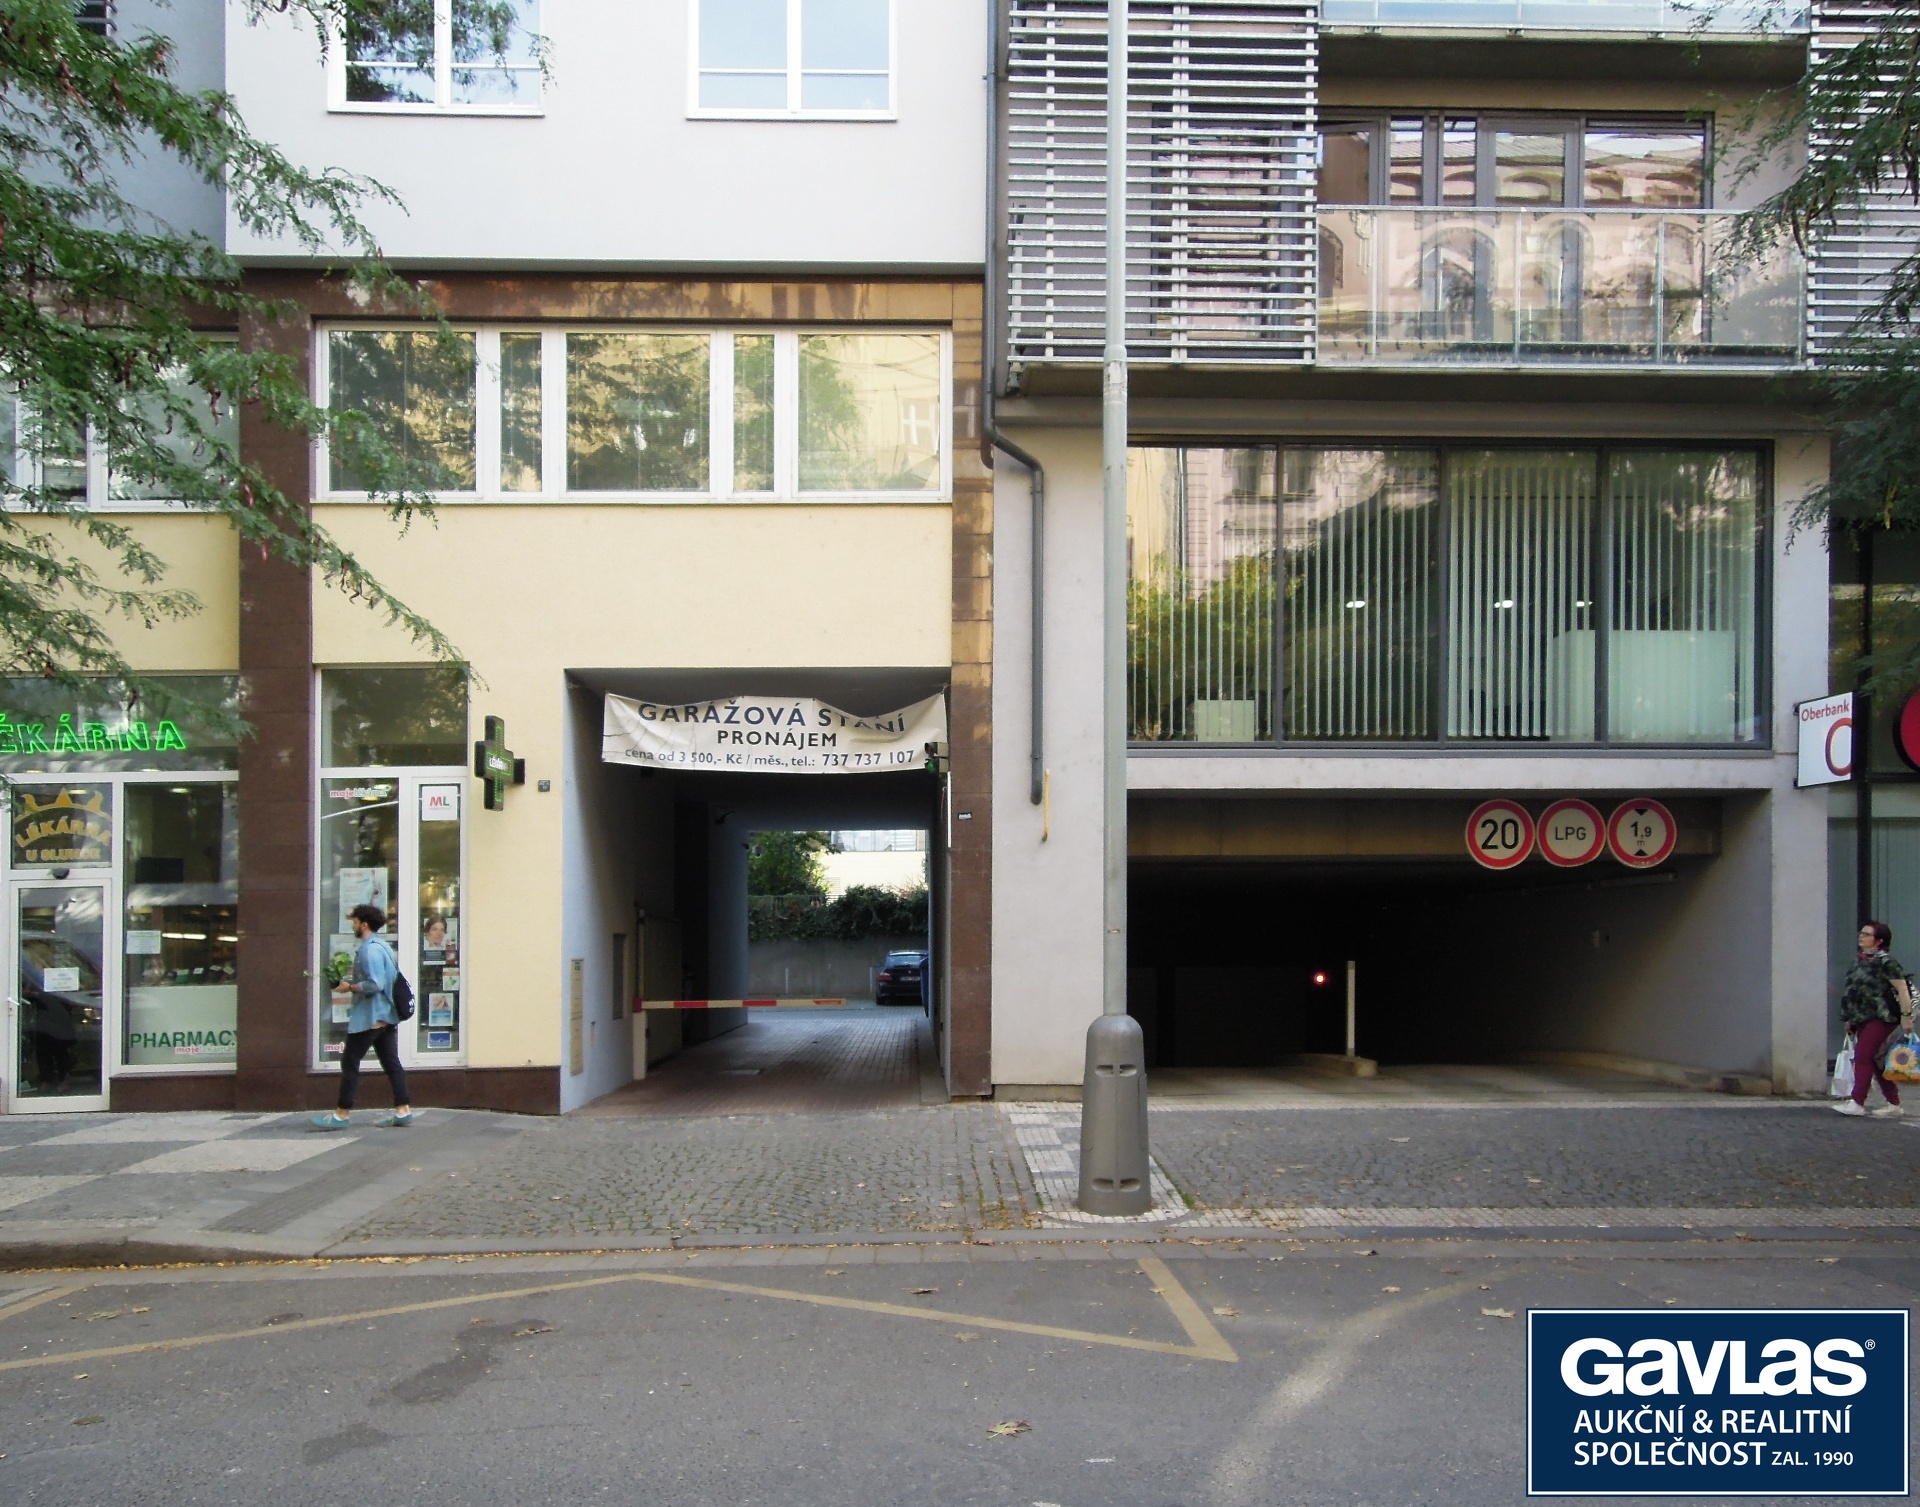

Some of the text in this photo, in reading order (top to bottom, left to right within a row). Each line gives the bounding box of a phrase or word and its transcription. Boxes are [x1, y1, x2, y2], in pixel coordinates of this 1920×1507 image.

[638, 700, 805, 727] GARÁŽOVÁ
[1801, 699, 1850, 721] Oberbank
[0, 713, 186, 753] ÉKÁRNA
[717, 728, 837, 750] PRONÁJEM
[625, 749, 654, 760] cena
[658, 751, 674, 762] od
[679, 751, 686, 762] 3
[691, 752, 721, 765] 500,-
[726, 753, 743, 764] Kč
[754, 755, 788, 767] měs.,
[791, 756, 815, 767] tel.:
[822, 753, 849, 766] 737
[855, 752, 882, 765] 737
[889, 750, 915, 763] 107
[429, 796, 450, 807] ML
[15, 815, 111, 848] LÉKÁRNA
[1481, 818, 1519, 850] 20
[1555, 826, 1587, 841] LPG
[26, 849, 38, 862] U
[130, 1030, 237, 1048] PHARMAC
